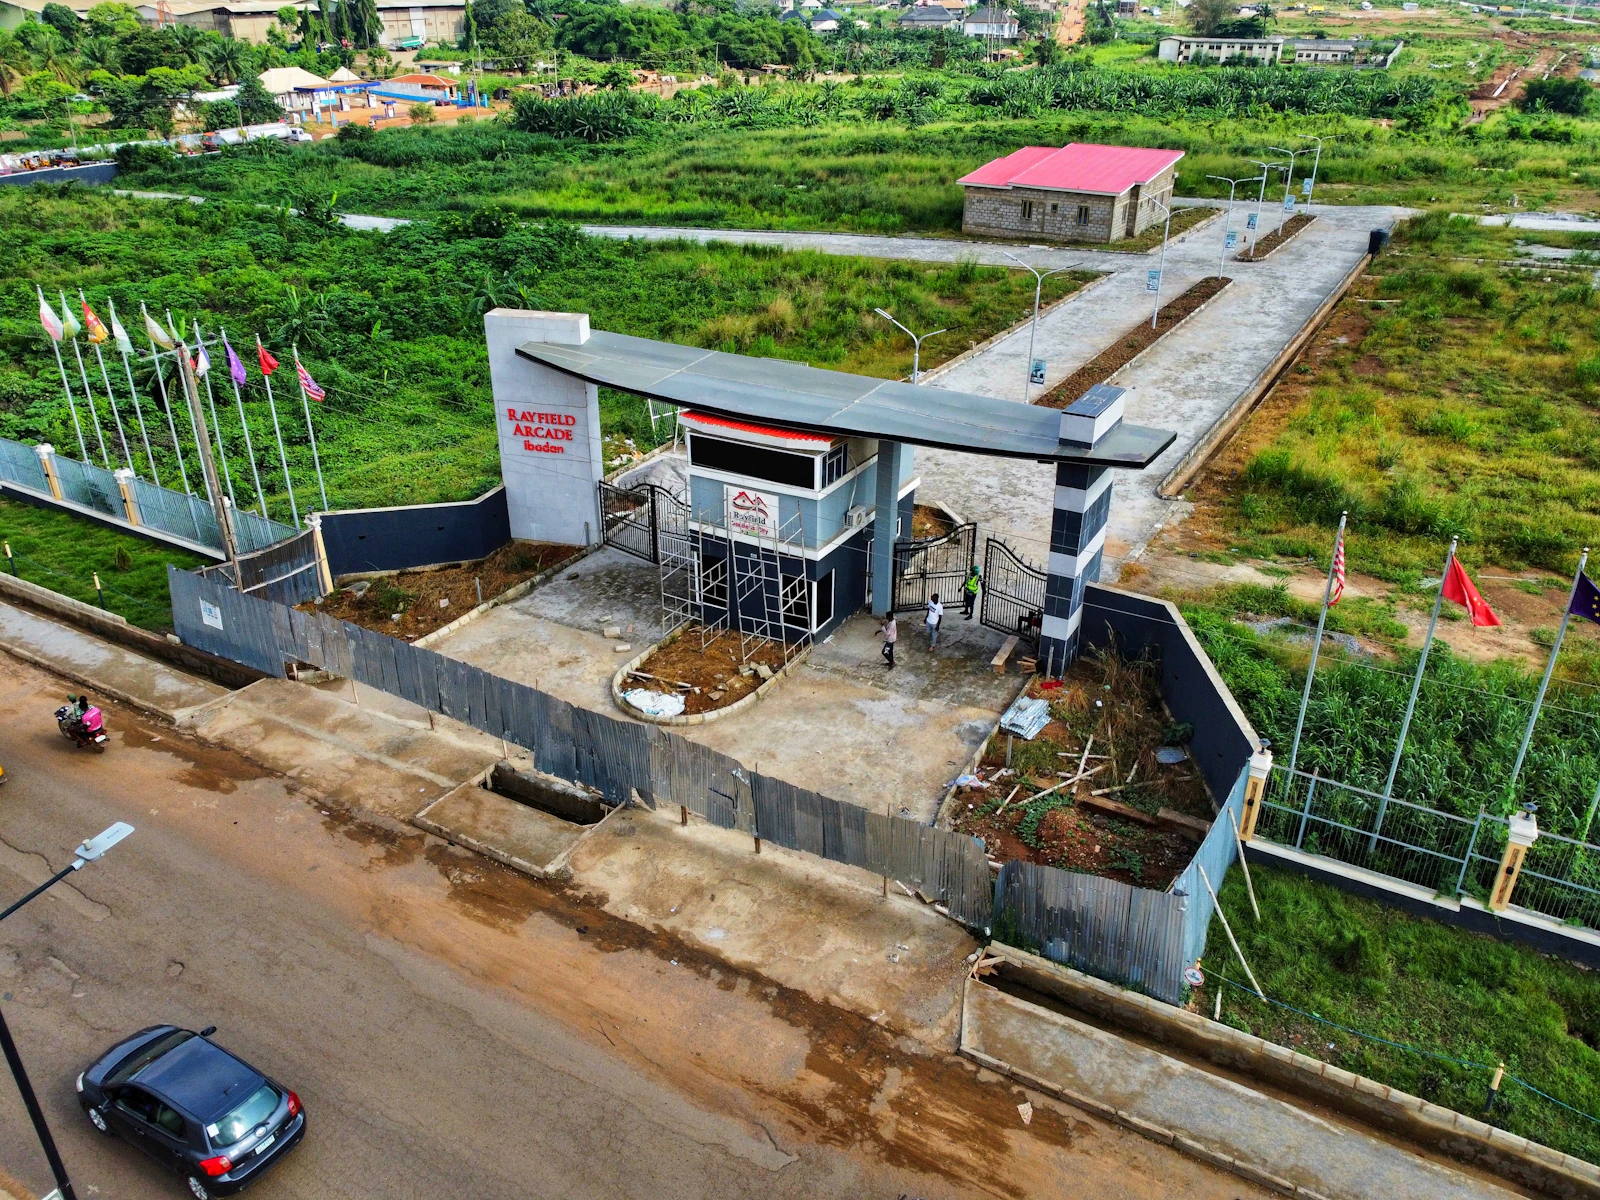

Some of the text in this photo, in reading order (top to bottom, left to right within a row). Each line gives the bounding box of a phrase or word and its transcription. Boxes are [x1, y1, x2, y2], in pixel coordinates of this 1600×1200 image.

[507, 408, 576, 426] RAYFIELD
[513, 423, 573, 441] ARCADE
[524, 440, 564, 454] ibadan
